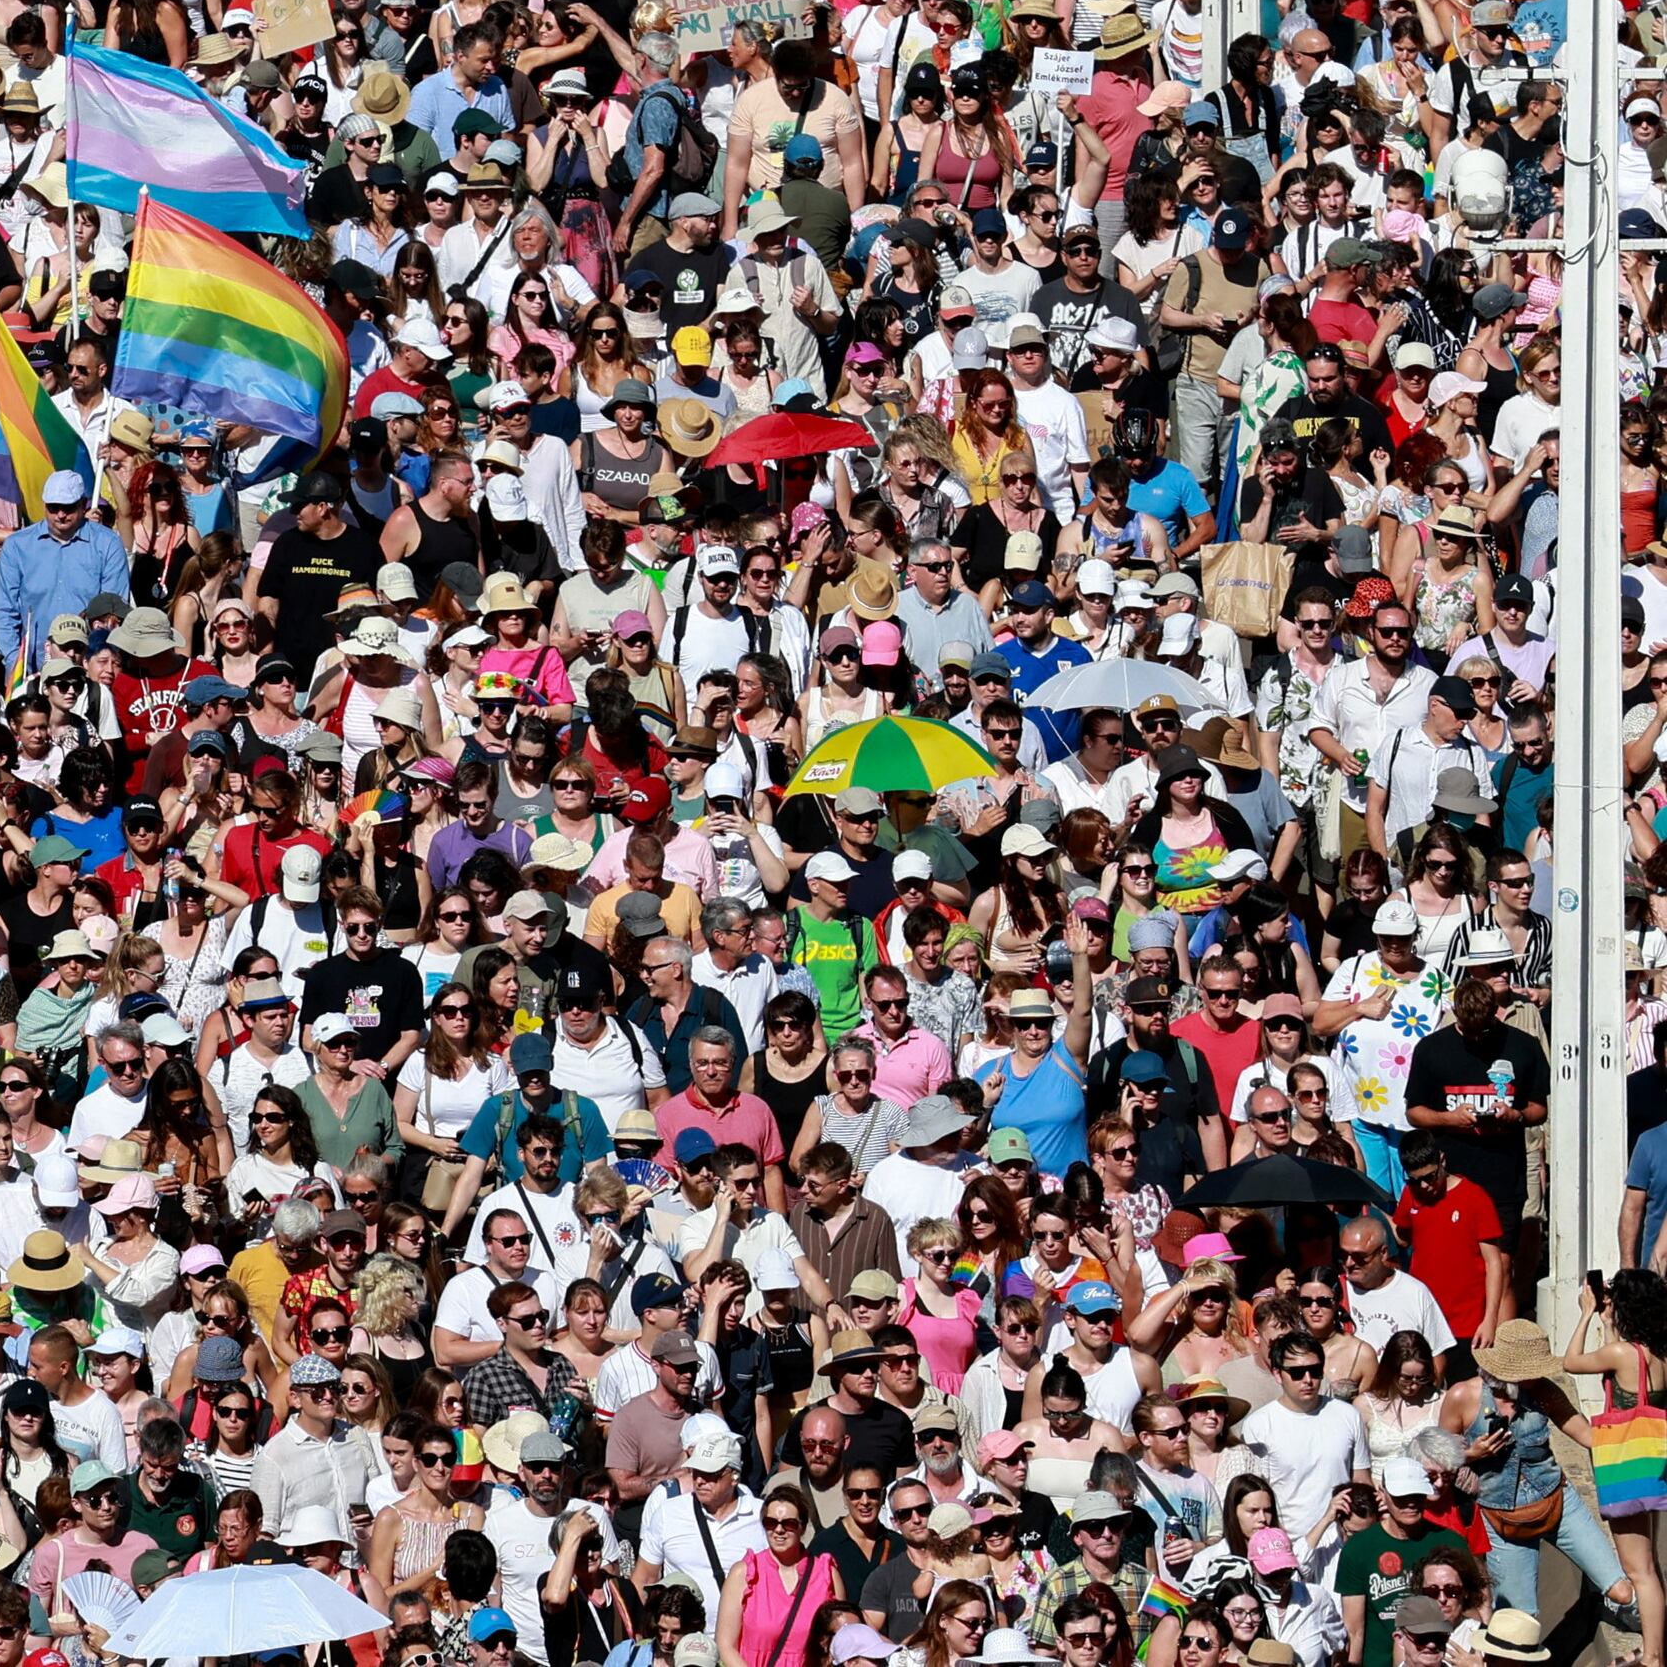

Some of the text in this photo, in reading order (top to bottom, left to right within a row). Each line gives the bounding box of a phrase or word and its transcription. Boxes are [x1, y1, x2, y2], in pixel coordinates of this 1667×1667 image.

[1043, 52, 1072, 64] Szájer
[595, 469, 650, 486] SZABAD
[310, 557, 334, 567] FUCK
[128, 689, 190, 717] STANFO
